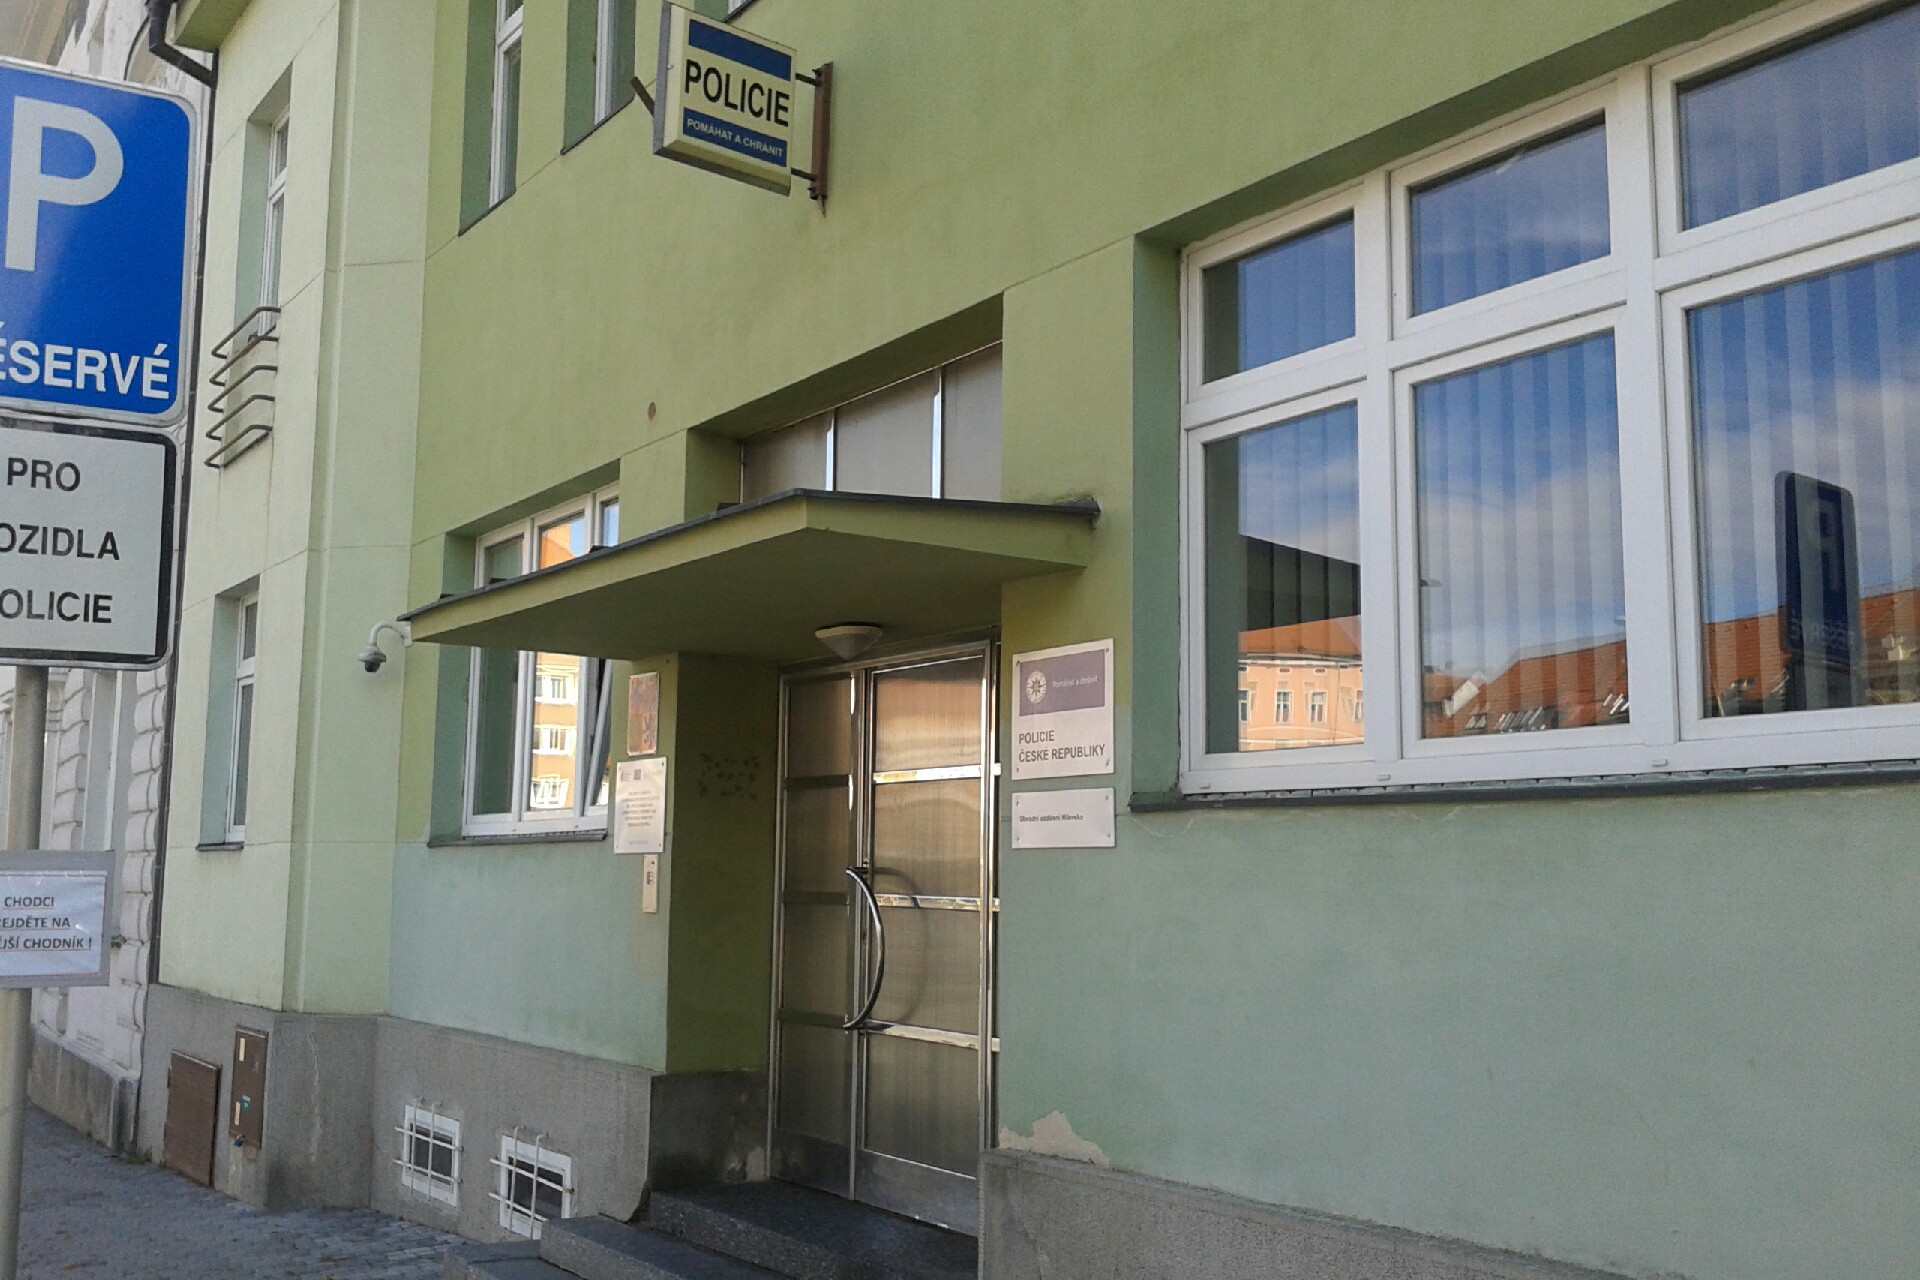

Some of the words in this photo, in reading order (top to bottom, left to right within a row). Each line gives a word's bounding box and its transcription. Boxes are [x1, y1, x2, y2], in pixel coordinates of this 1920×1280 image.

[684, 59, 790, 127] POLICIE
[734, 134, 742, 144] A
[5, 96, 124, 272] P
[0, 321, 170, 399] SERVÉ
[7, 457, 81, 492] PRO
[1018, 729, 1055, 745] POLICIE
[1018, 746, 1049, 763] ČESKÉ
[1051, 743, 1105, 760] REPUBLIKY
[4, 896, 54, 907] CHODCI
[0, 915, 48, 928] EJDĚTE
[52, 917, 71, 928] NA
[23, 935, 83, 949] CHODNÍK
